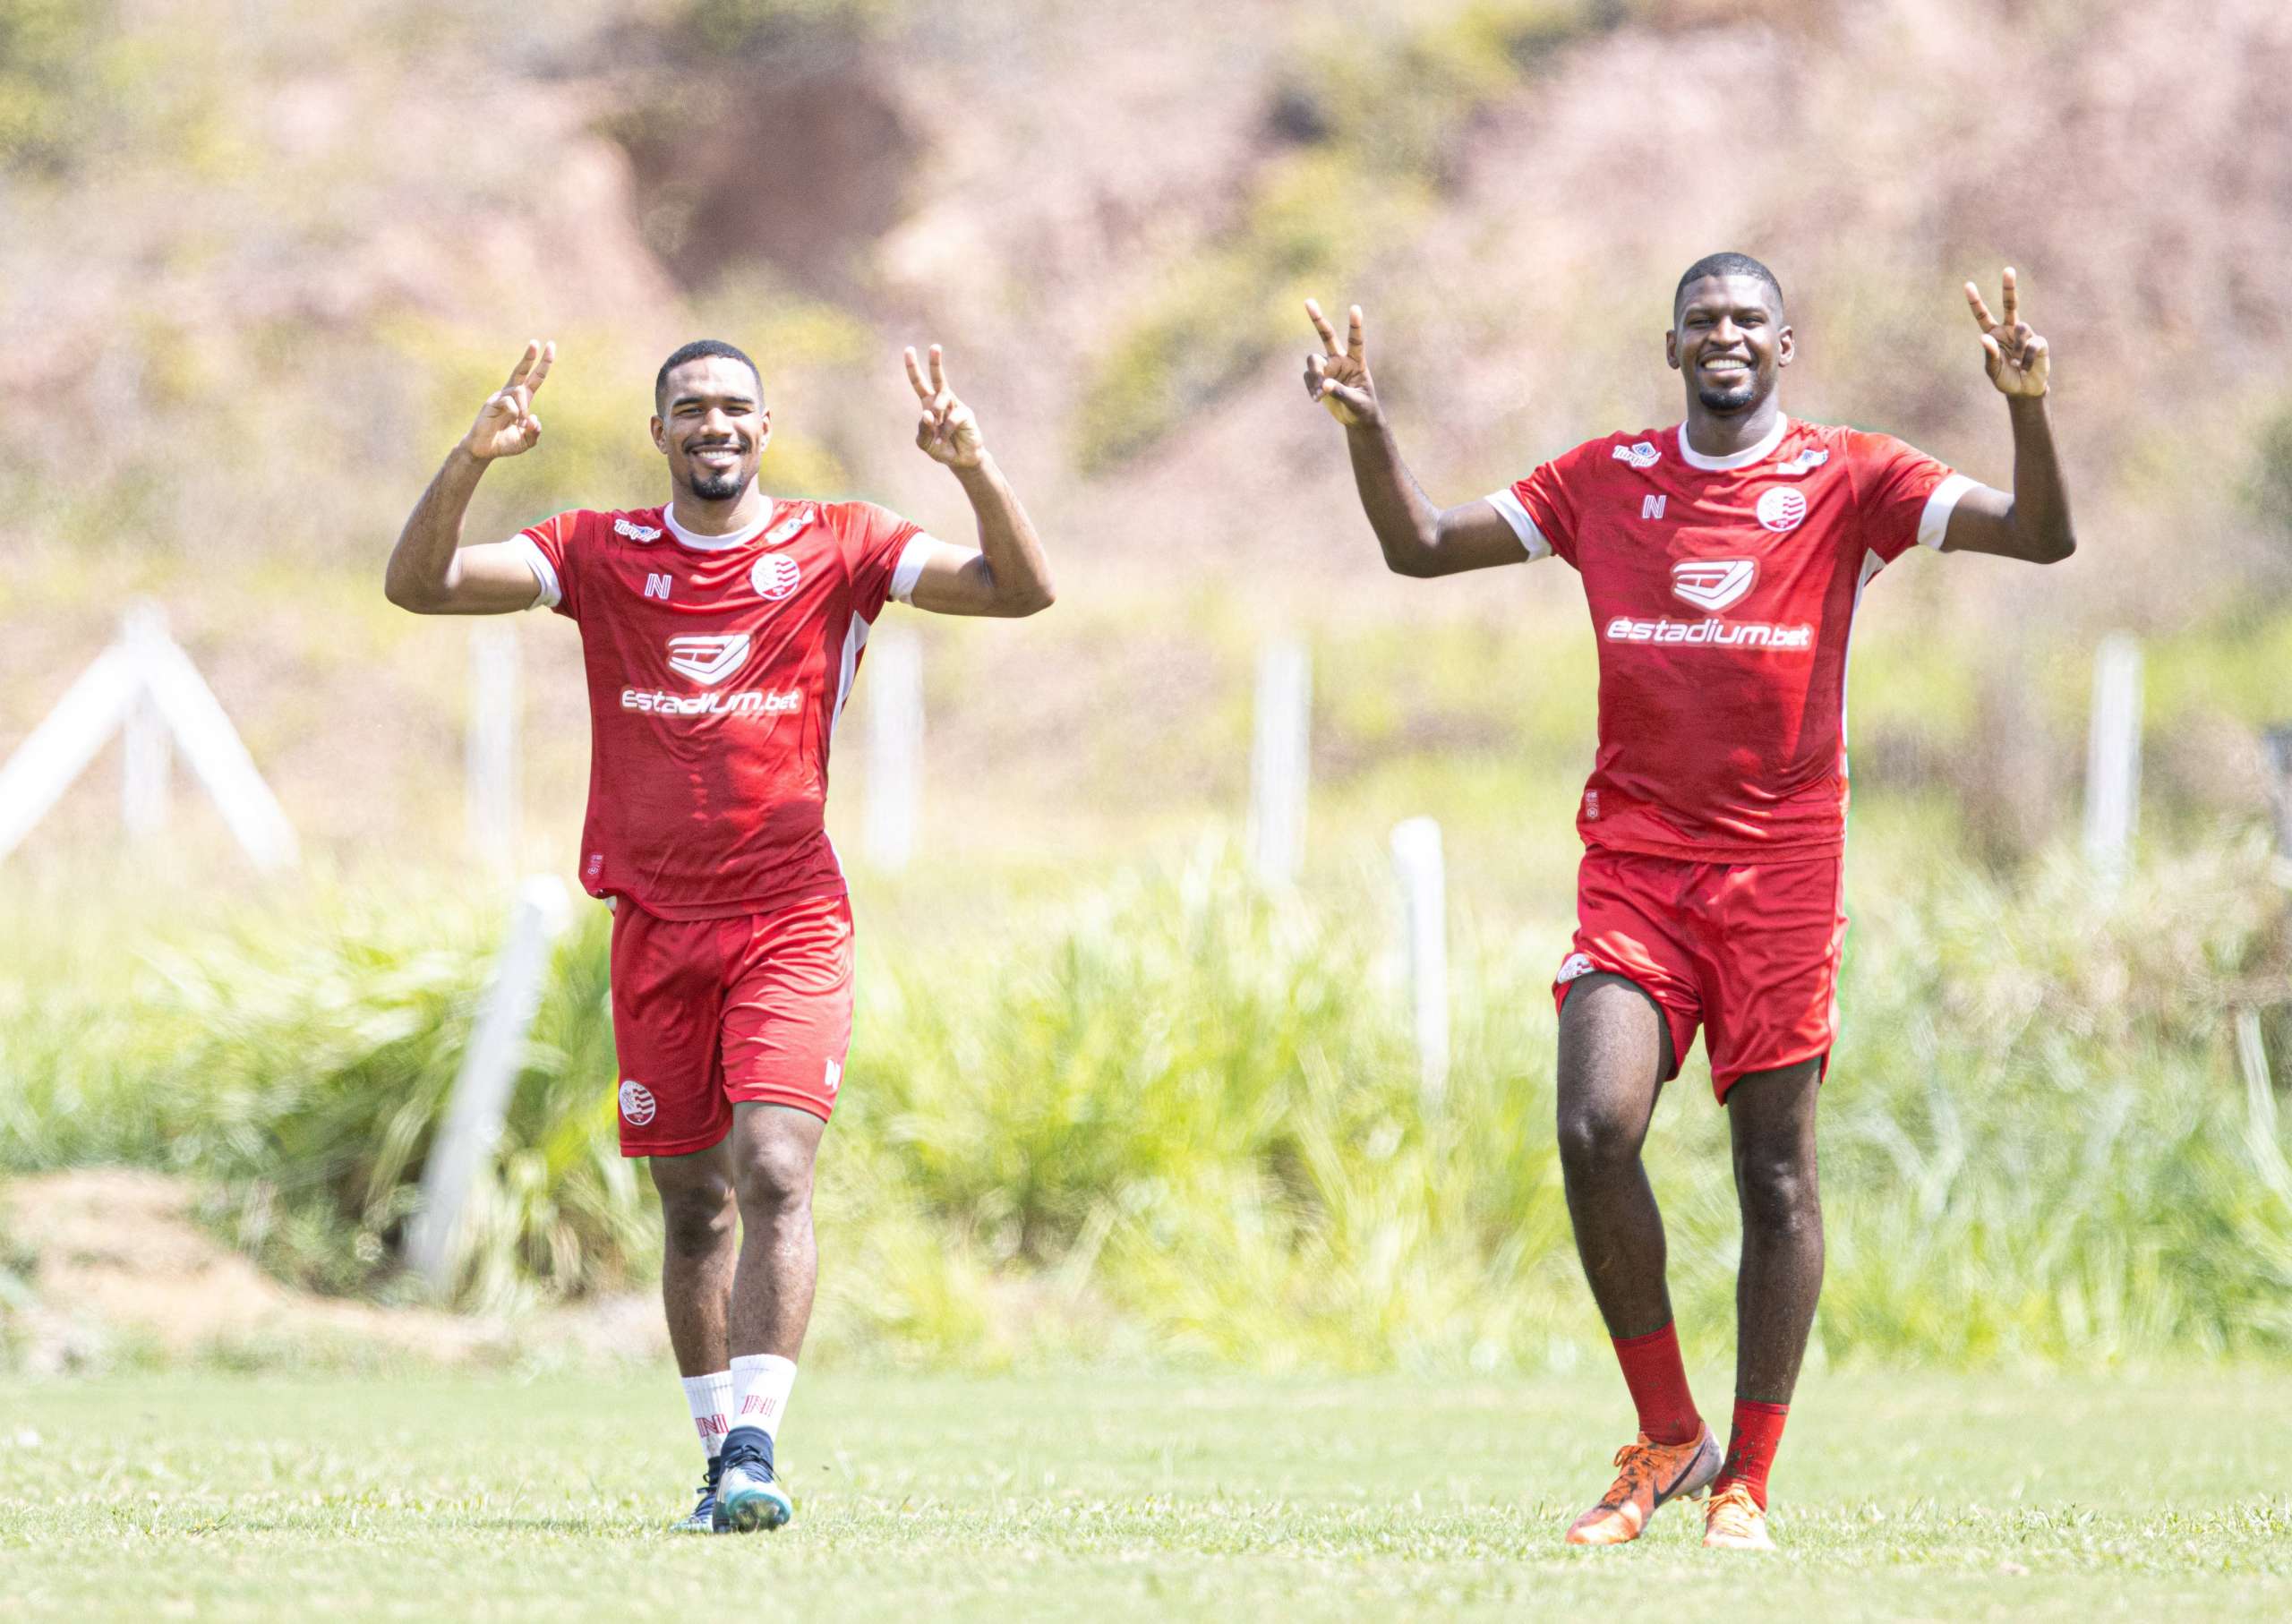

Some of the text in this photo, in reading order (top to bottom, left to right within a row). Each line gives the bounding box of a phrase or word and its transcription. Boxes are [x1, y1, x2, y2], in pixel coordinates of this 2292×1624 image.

[1642, 494, 1666, 518] N
[645, 573, 672, 600] N
[1607, 618, 1809, 645] estadium.bet
